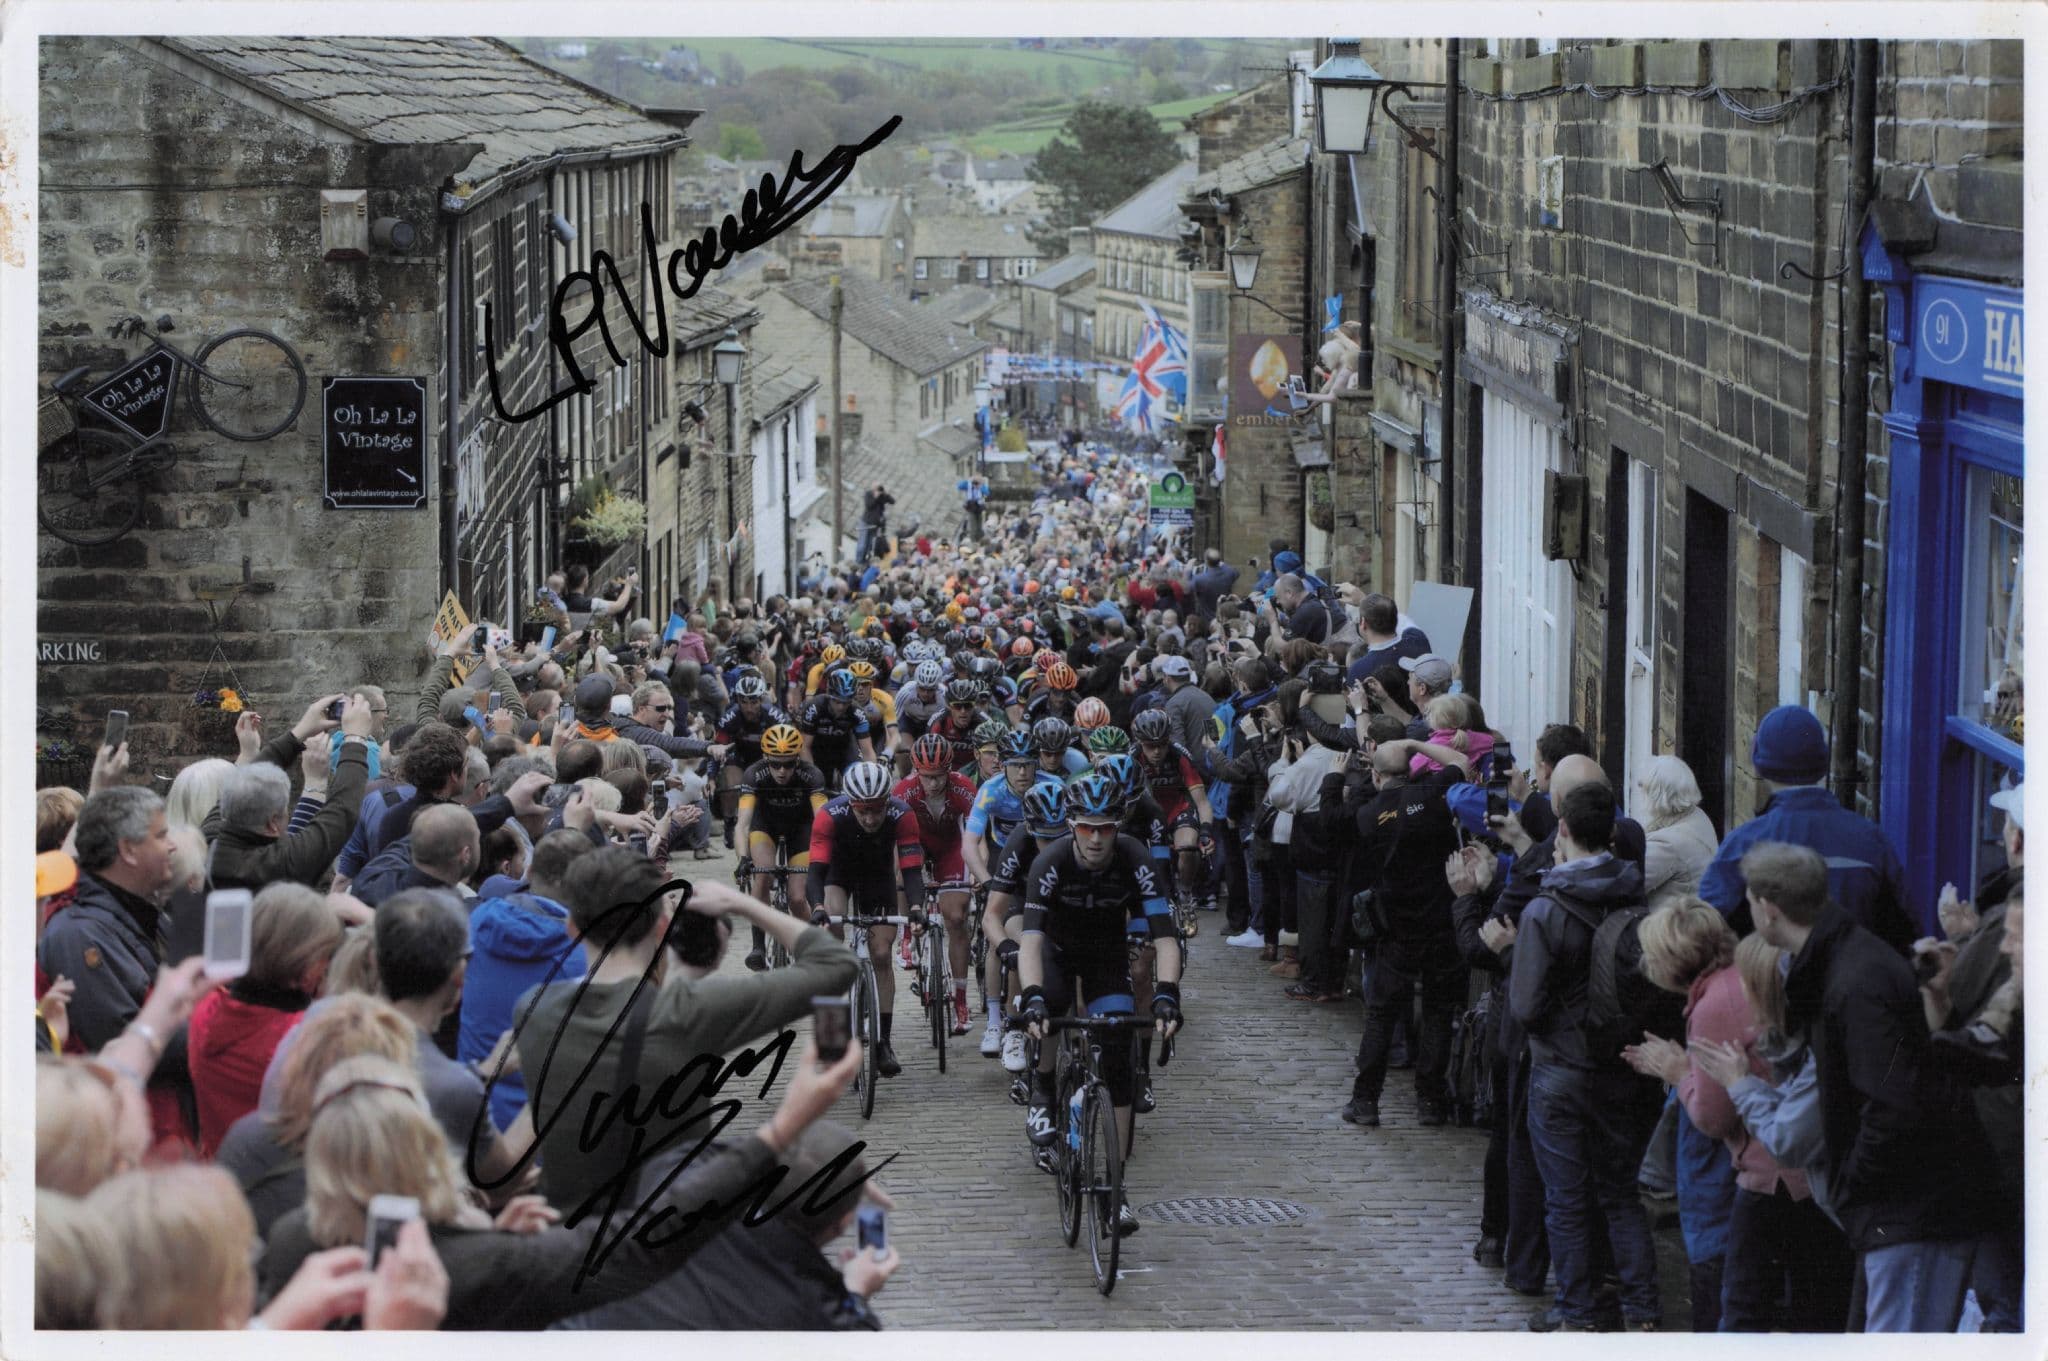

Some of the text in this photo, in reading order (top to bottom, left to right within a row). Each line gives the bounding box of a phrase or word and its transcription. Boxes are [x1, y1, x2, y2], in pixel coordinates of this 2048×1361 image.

[1935, 314, 1950, 345] 91
[102, 364, 162, 409] Oh La La
[117, 384, 166, 417] Vintage
[333, 404, 417, 425] Oh La La
[338, 431, 414, 452] Vintage
[330, 489, 420, 500] www.ohlalavintage.co.uk
[1001, 851, 1020, 878] sky
[1134, 864, 1157, 896] sky
[1039, 865, 1059, 897] sky
